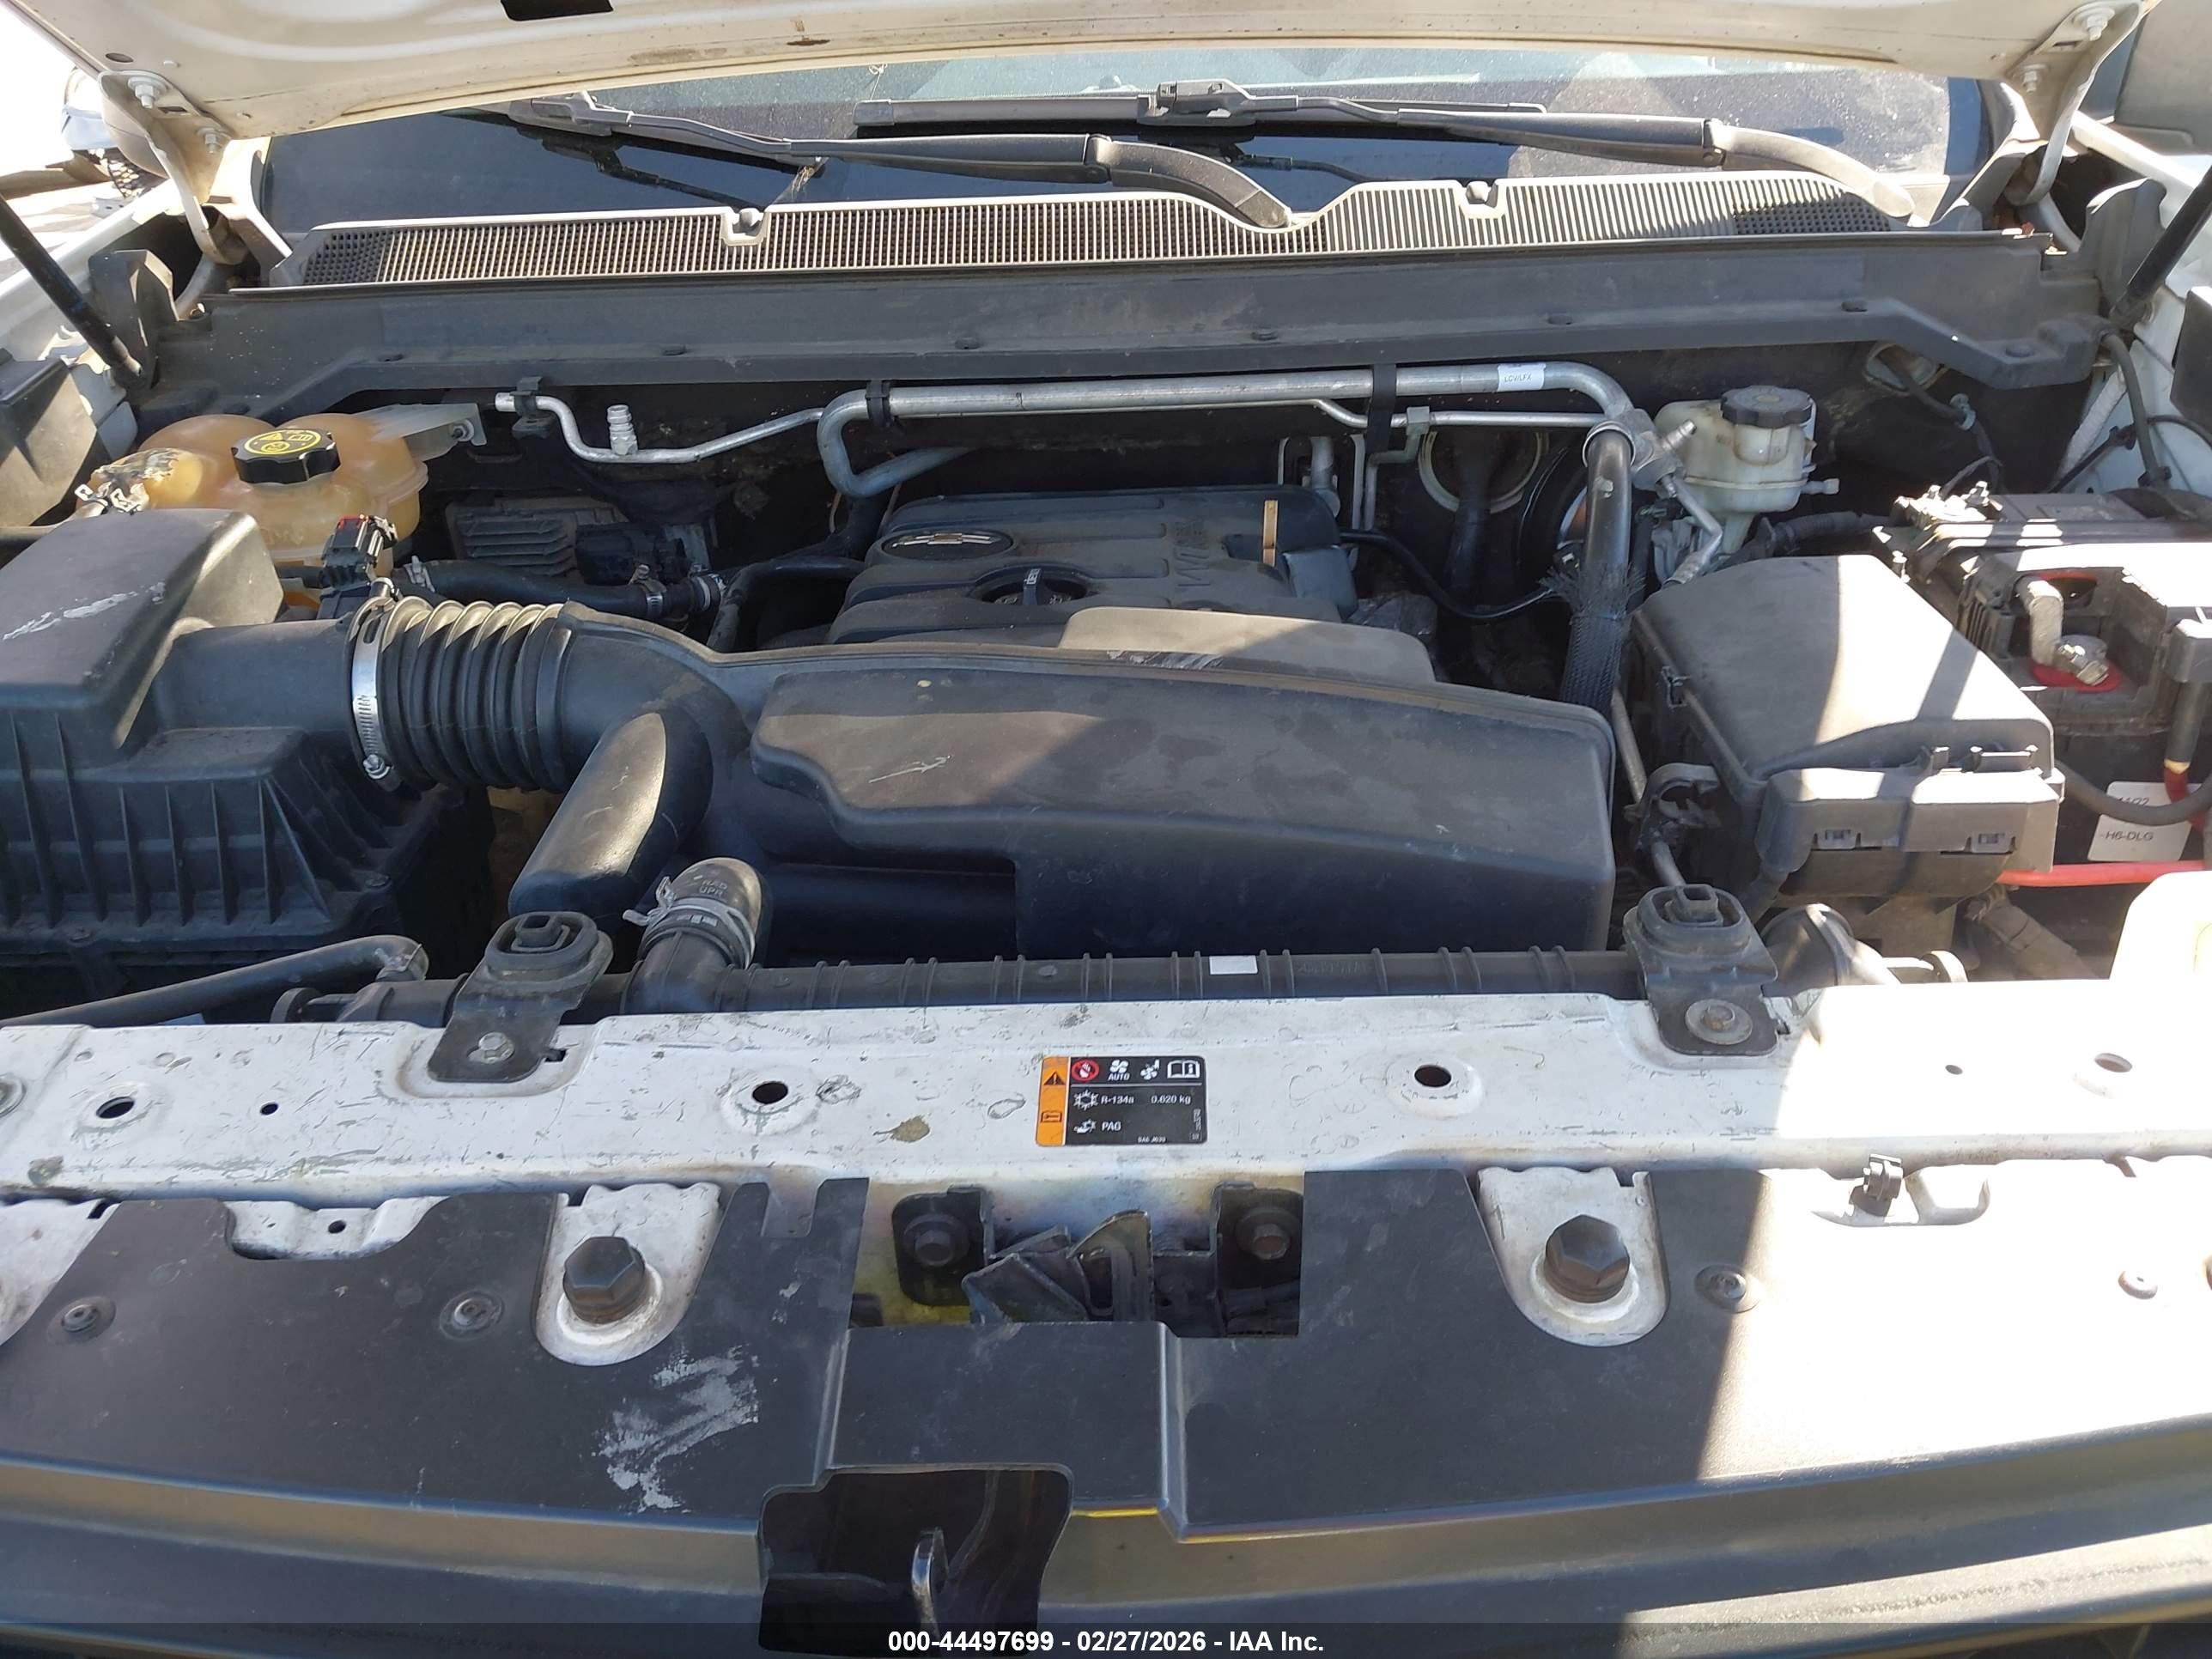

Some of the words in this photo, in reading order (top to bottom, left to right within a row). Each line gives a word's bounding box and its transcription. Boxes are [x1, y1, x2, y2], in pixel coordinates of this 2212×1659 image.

[1108, 1073, 1131, 1081] AUTO
[1179, 1095, 1192, 1105] kg
[1102, 1121, 1121, 1132] PAG
